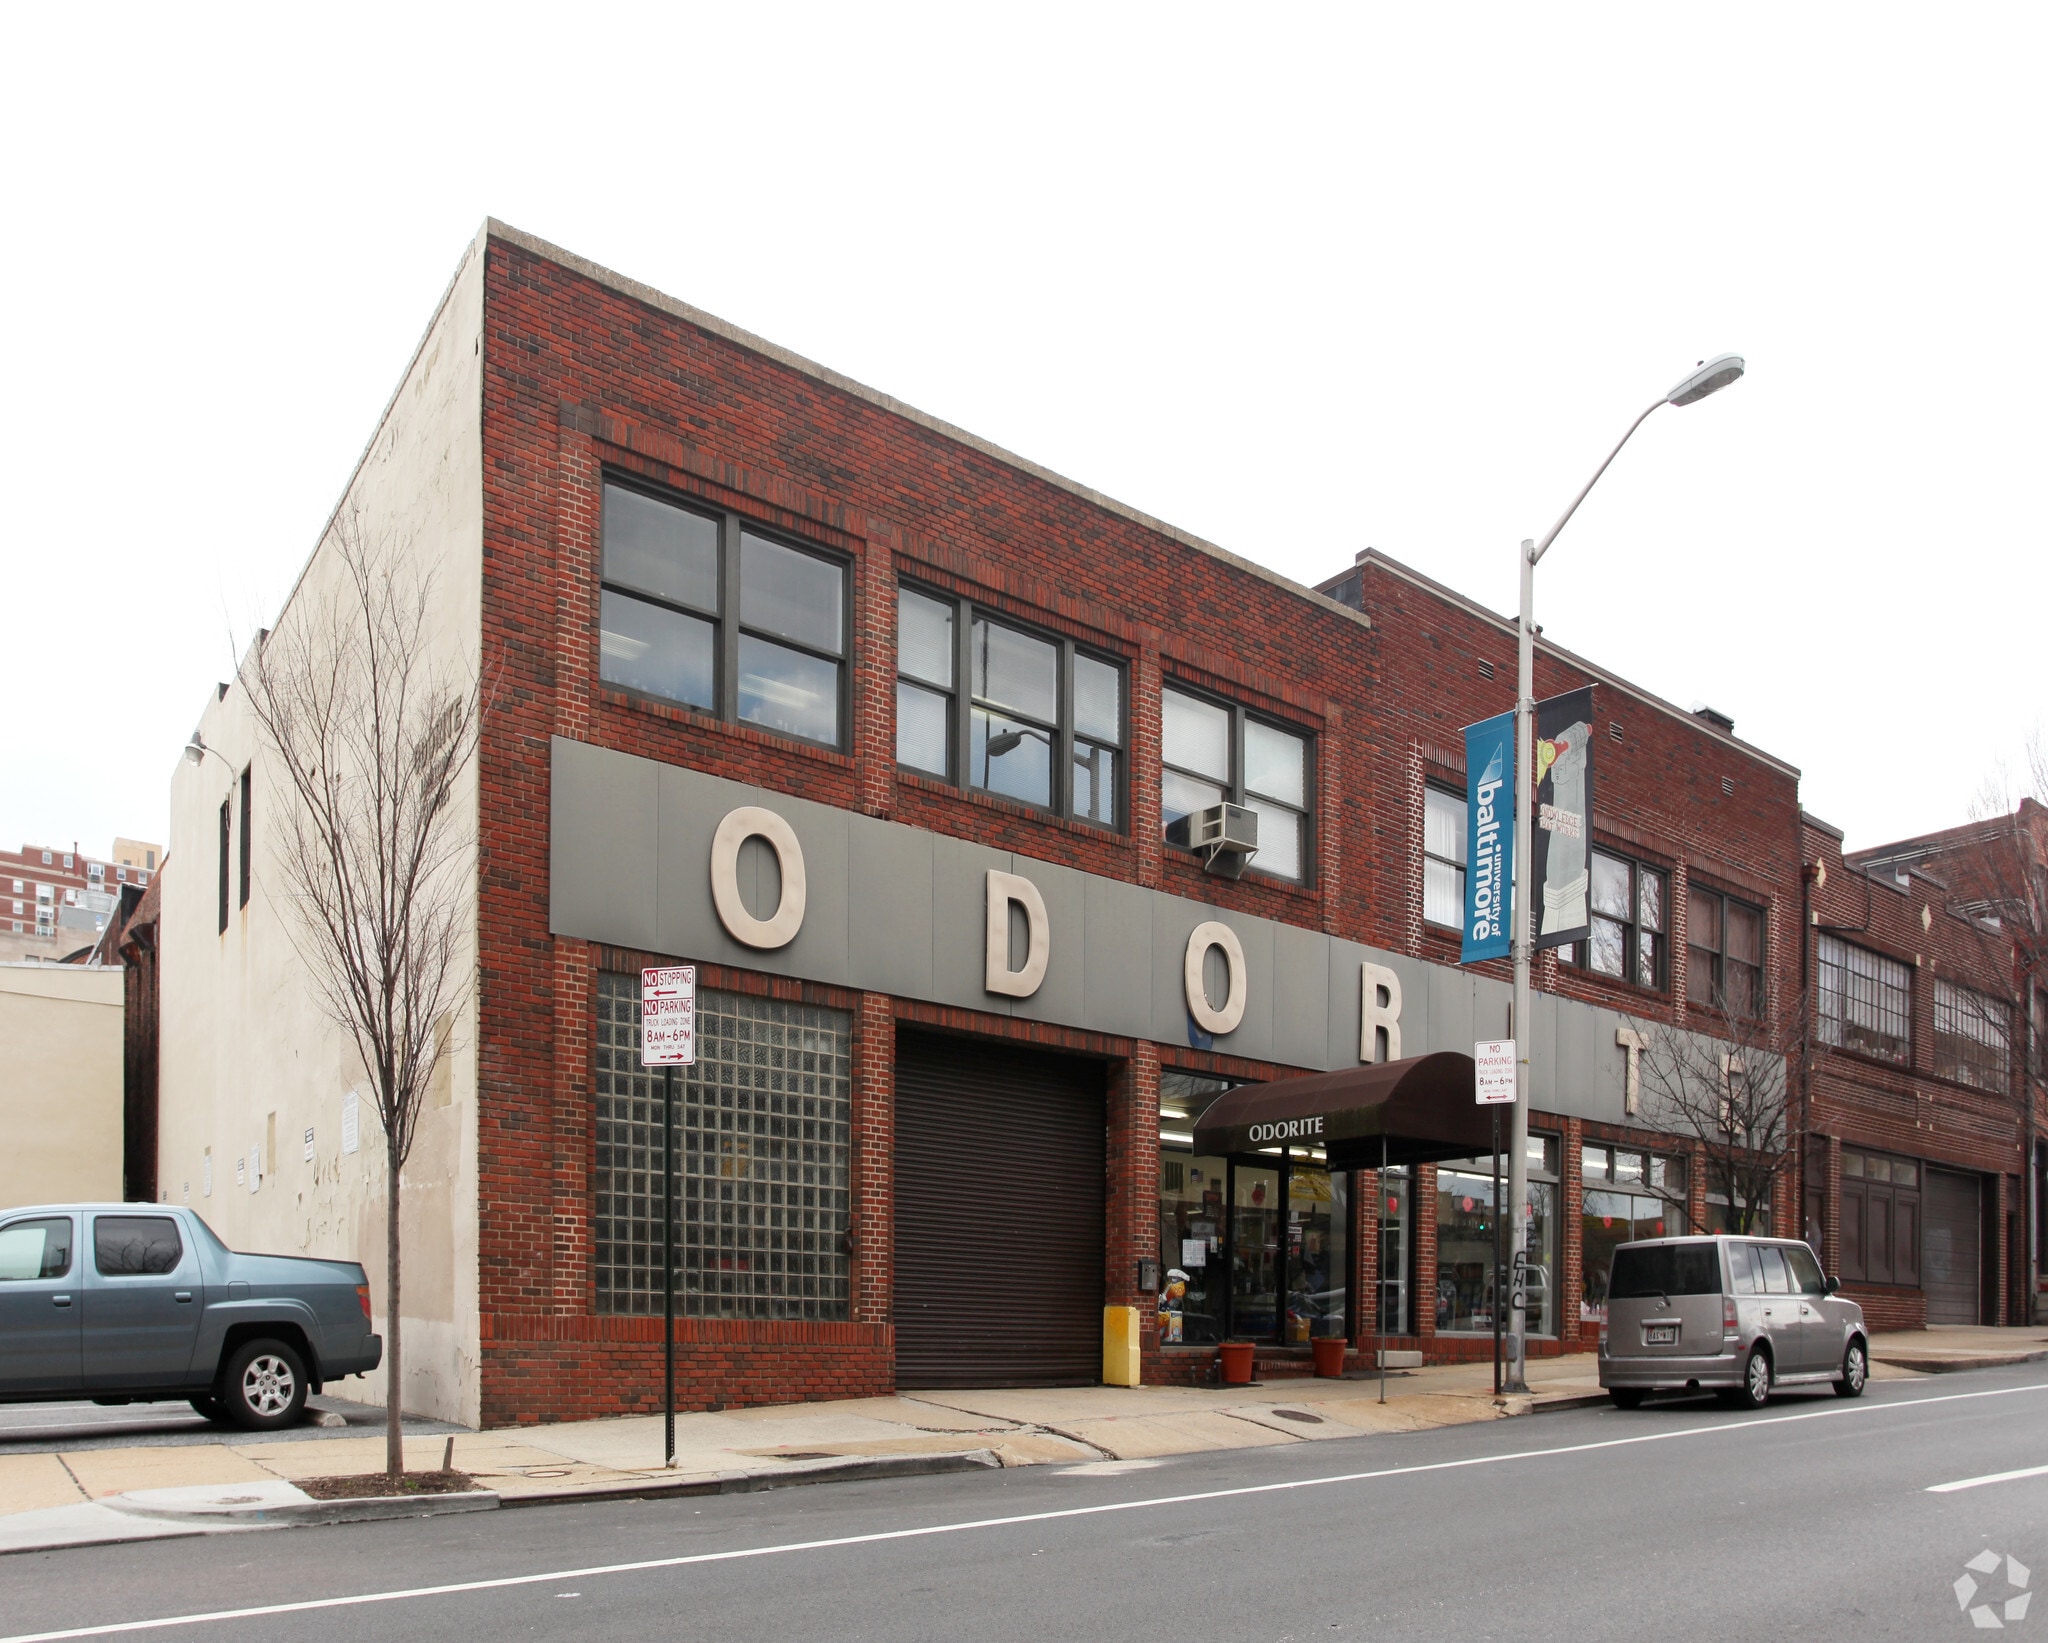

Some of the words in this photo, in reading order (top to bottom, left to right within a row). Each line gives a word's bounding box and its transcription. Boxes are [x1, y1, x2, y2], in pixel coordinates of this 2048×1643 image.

[1472, 779, 1503, 941] baltimore
[1491, 853, 1502, 921] university
[1491, 922, 1502, 937] of
[644, 972, 657, 986] NO
[660, 971, 691, 985] STOPPING
[644, 1001, 657, 1014] NO
[660, 1000, 691, 1014] PARKING
[646, 1018, 659, 1027] TRUCK
[661, 1017, 678, 1026] LOADING
[680, 1016, 691, 1026] ZONE
[1489, 1044, 1500, 1053] NO
[1478, 1056, 1512, 1066] PARKING
[1248, 1116, 1324, 1142] ODORITE
